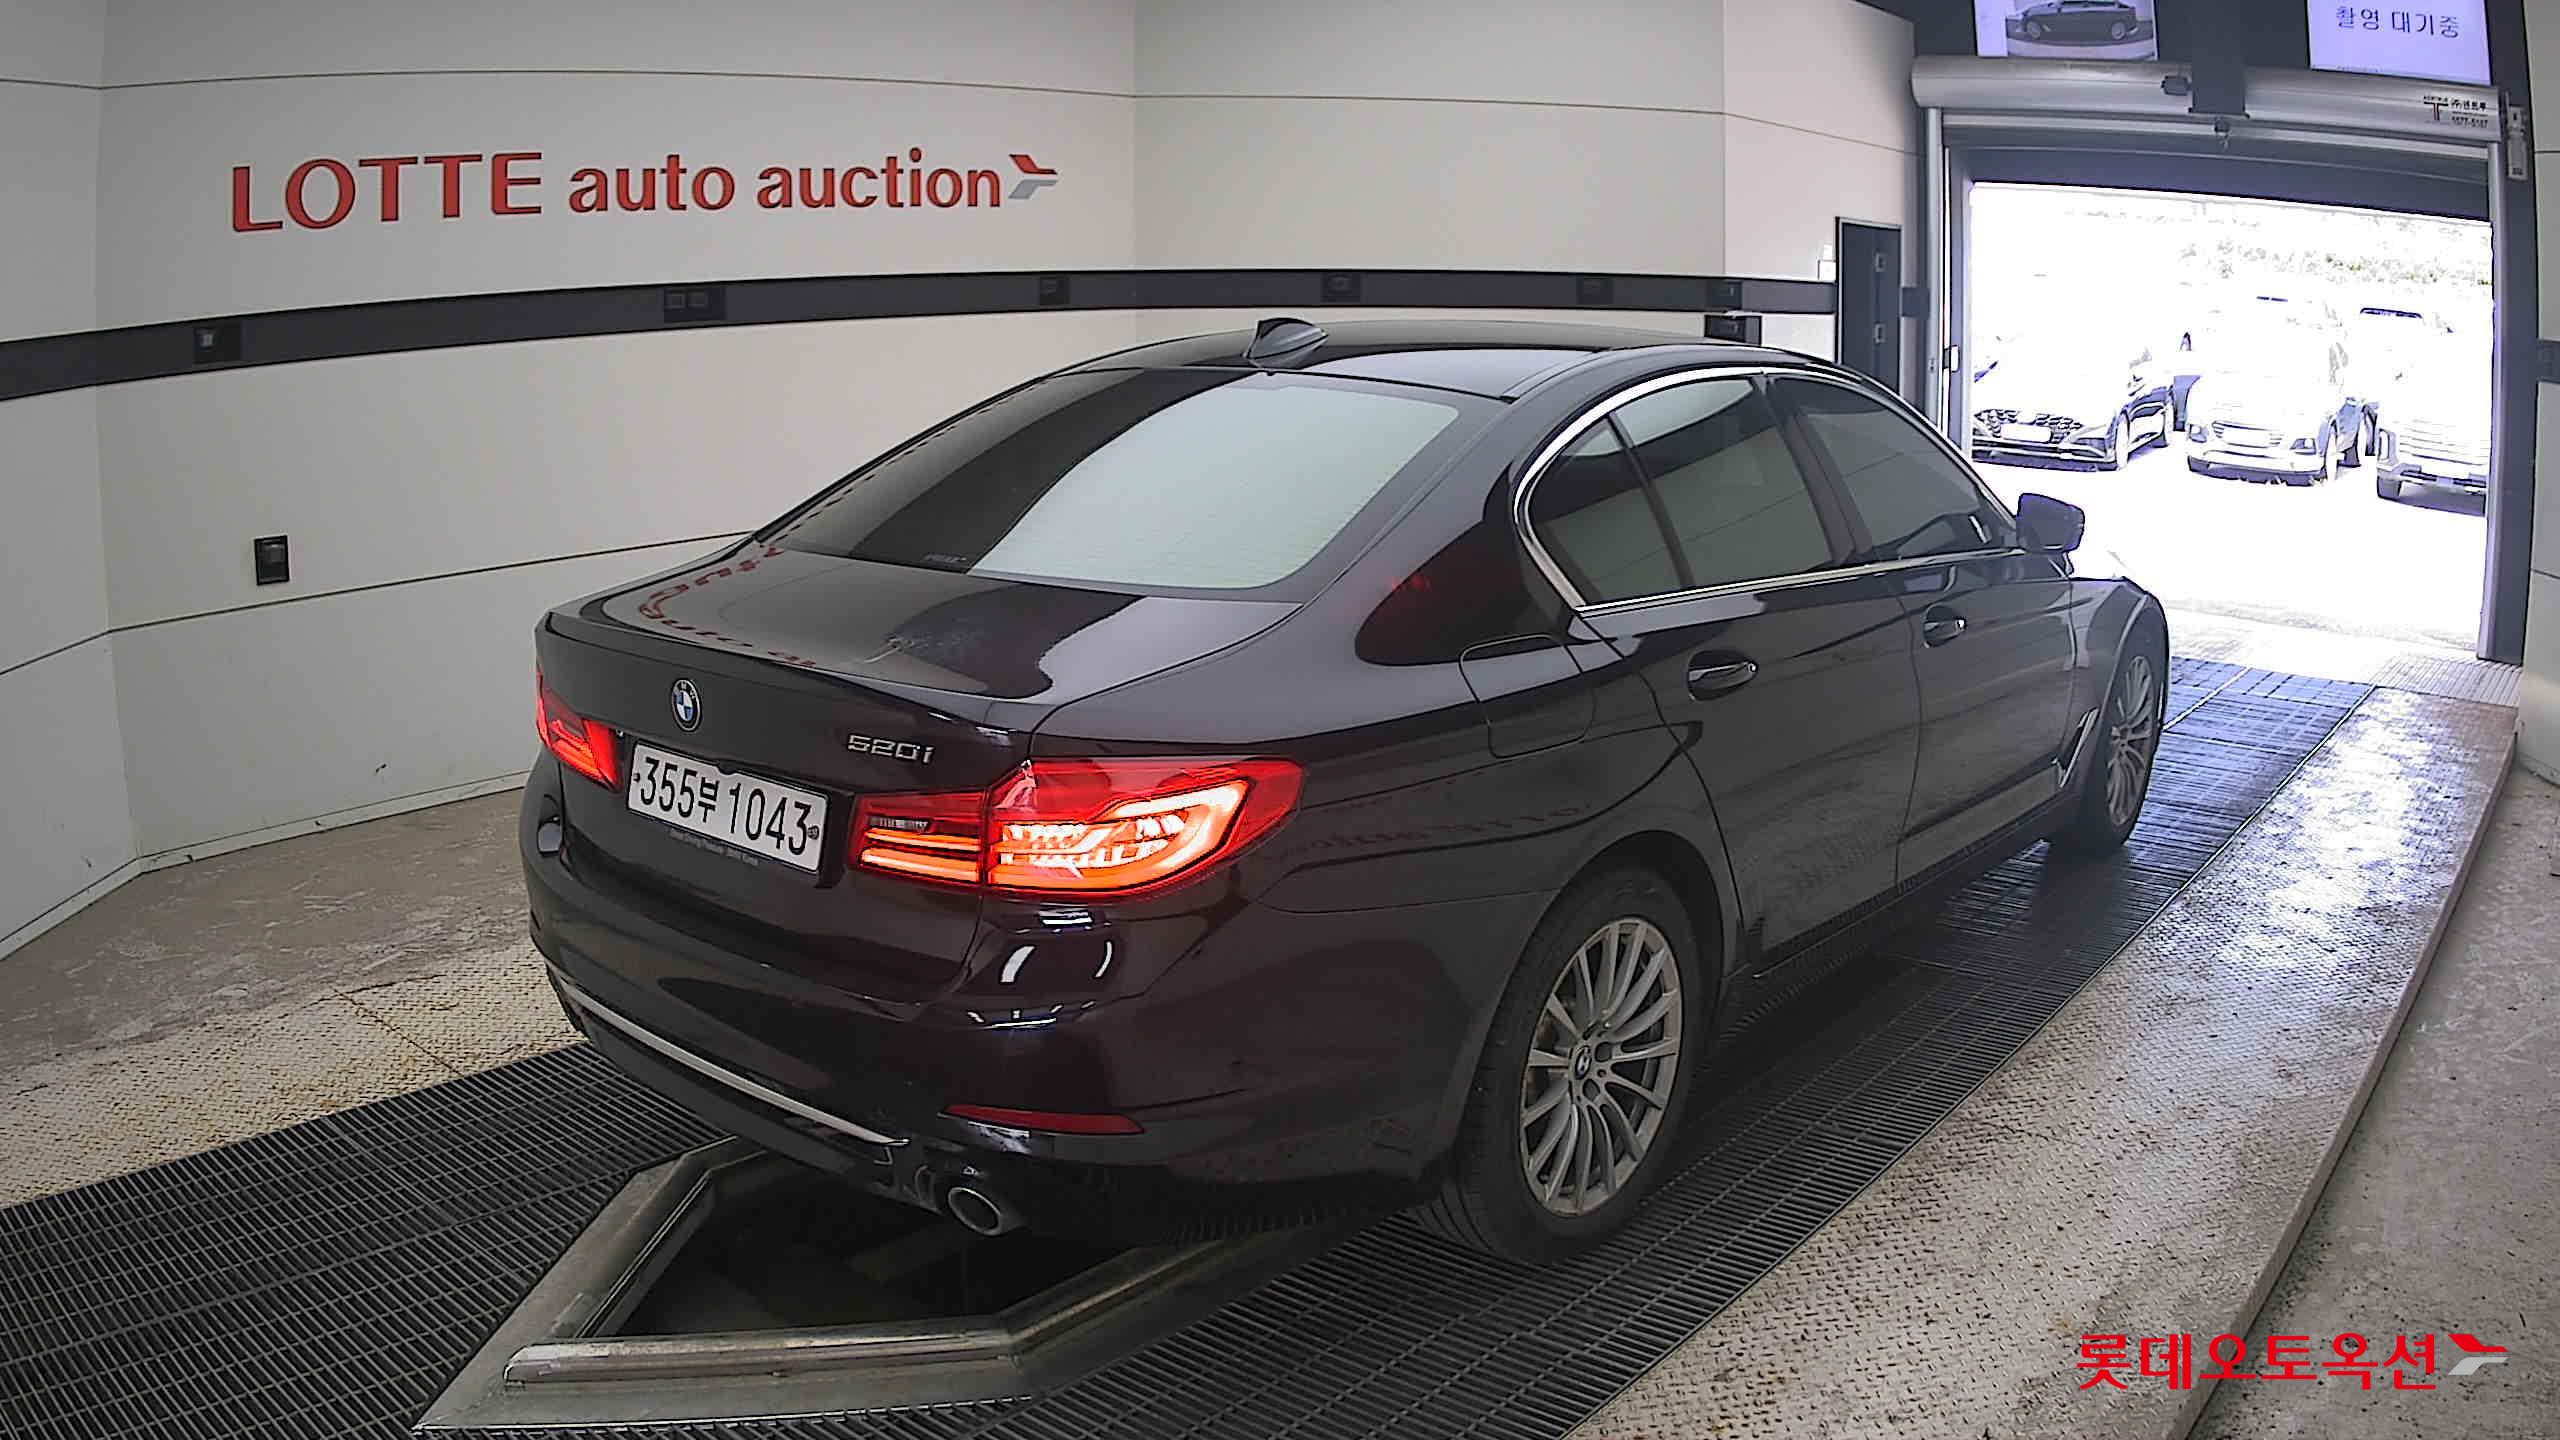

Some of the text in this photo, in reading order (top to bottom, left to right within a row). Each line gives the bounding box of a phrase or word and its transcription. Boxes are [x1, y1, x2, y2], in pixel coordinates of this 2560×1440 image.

[2336, 6, 2459, 38] 촬영 대기중
[232, 146, 1001, 232] LOTTE auto auction
[847, 734, 935, 763] 520i
[640, 757, 720, 823] 355부
[729, 782, 811, 855] 1043
